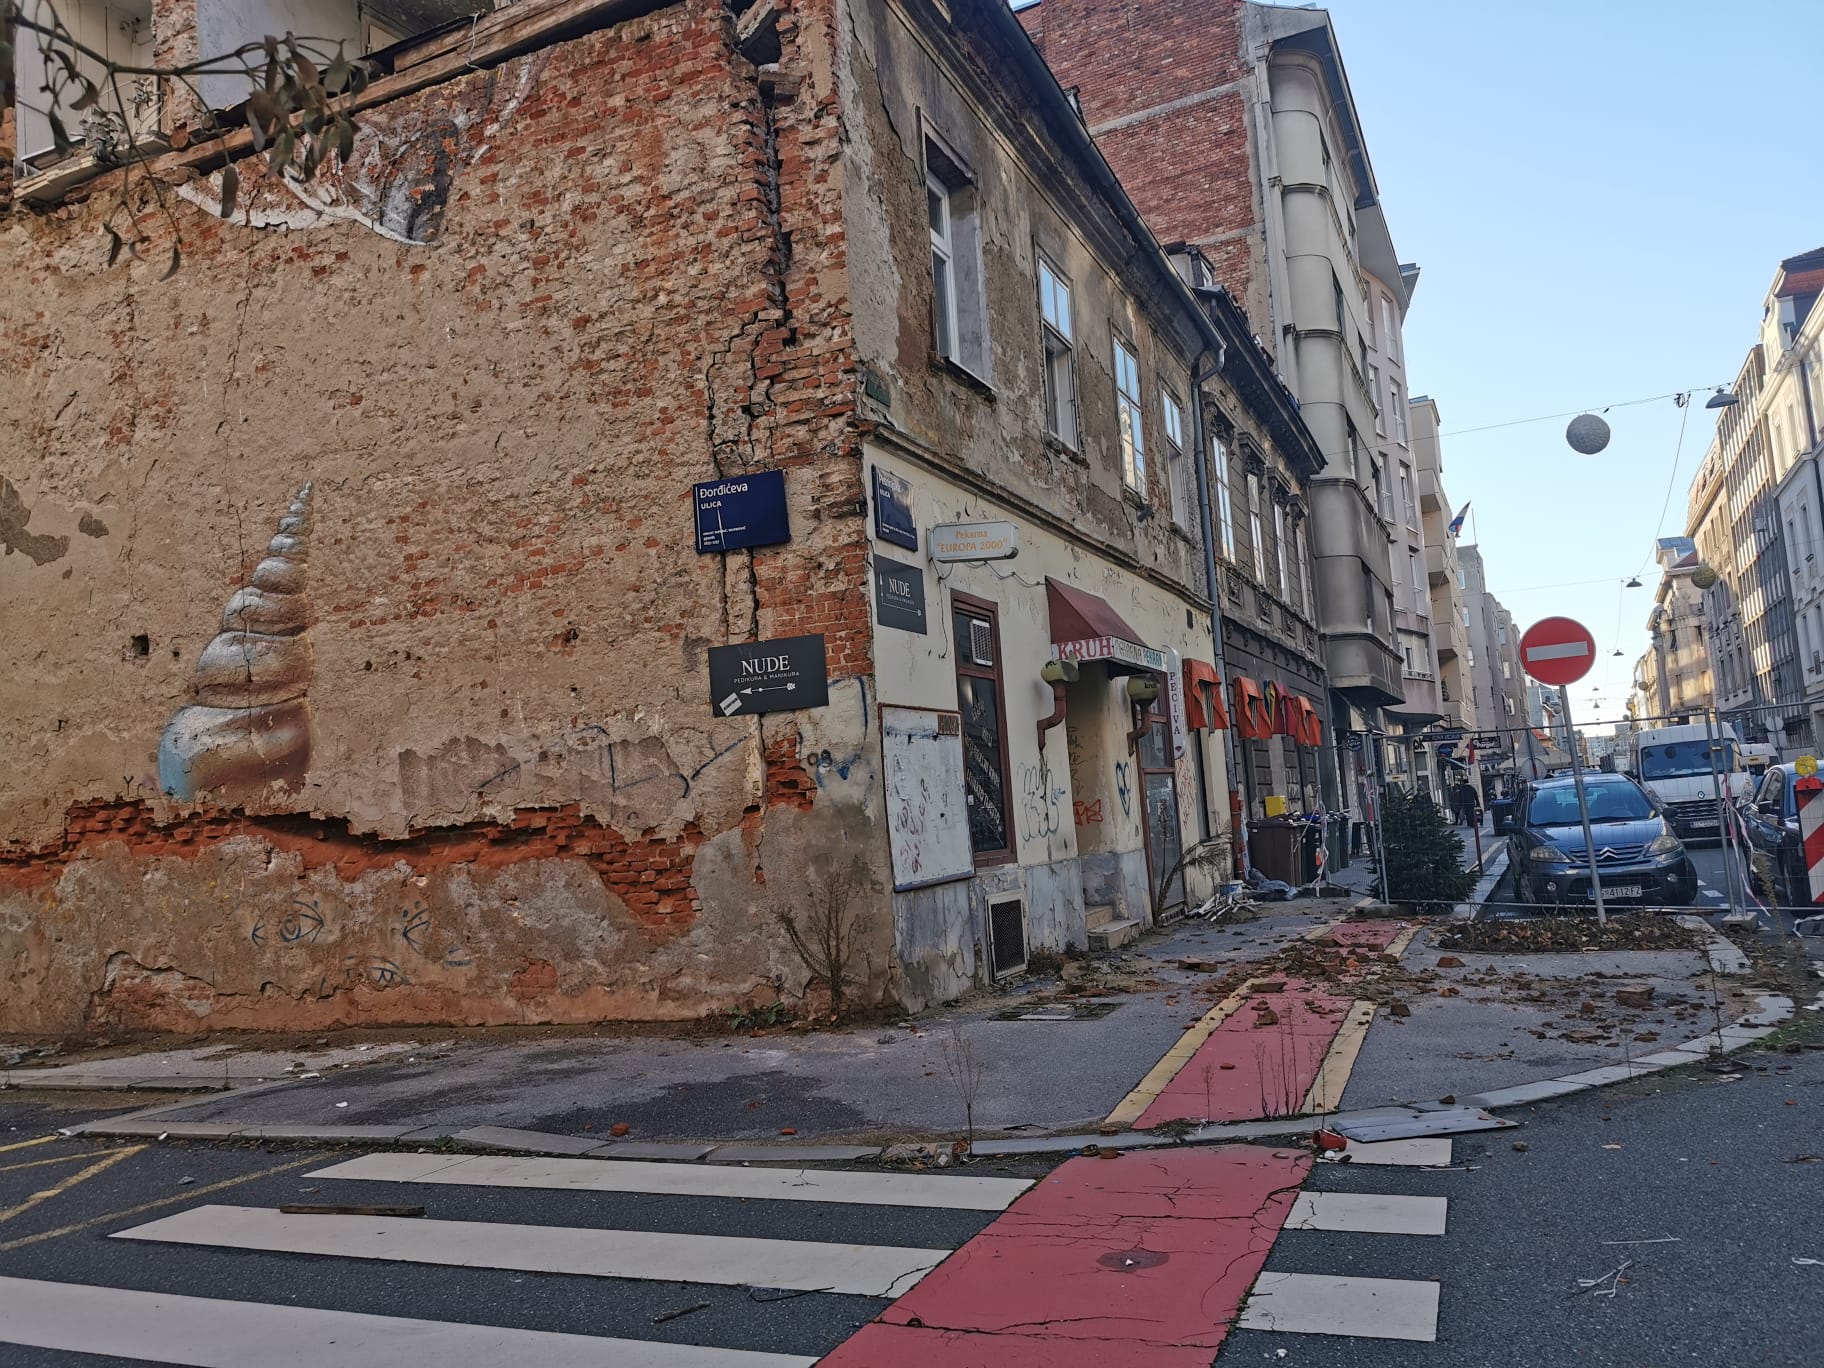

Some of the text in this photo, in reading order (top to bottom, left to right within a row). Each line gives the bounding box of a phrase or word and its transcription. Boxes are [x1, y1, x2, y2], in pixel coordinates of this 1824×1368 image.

[700, 483, 748, 498] Đorđićeva
[700, 500, 722, 510] ULICA
[888, 577, 911, 598] NUDE
[1056, 636, 1113, 661] KRUH
[740, 655, 790, 676] NUDE
[733, 675, 762, 684] PEDIKURA
[769, 671, 800, 680] MANIKURA
[1168, 671, 1181, 735] PECIVA
